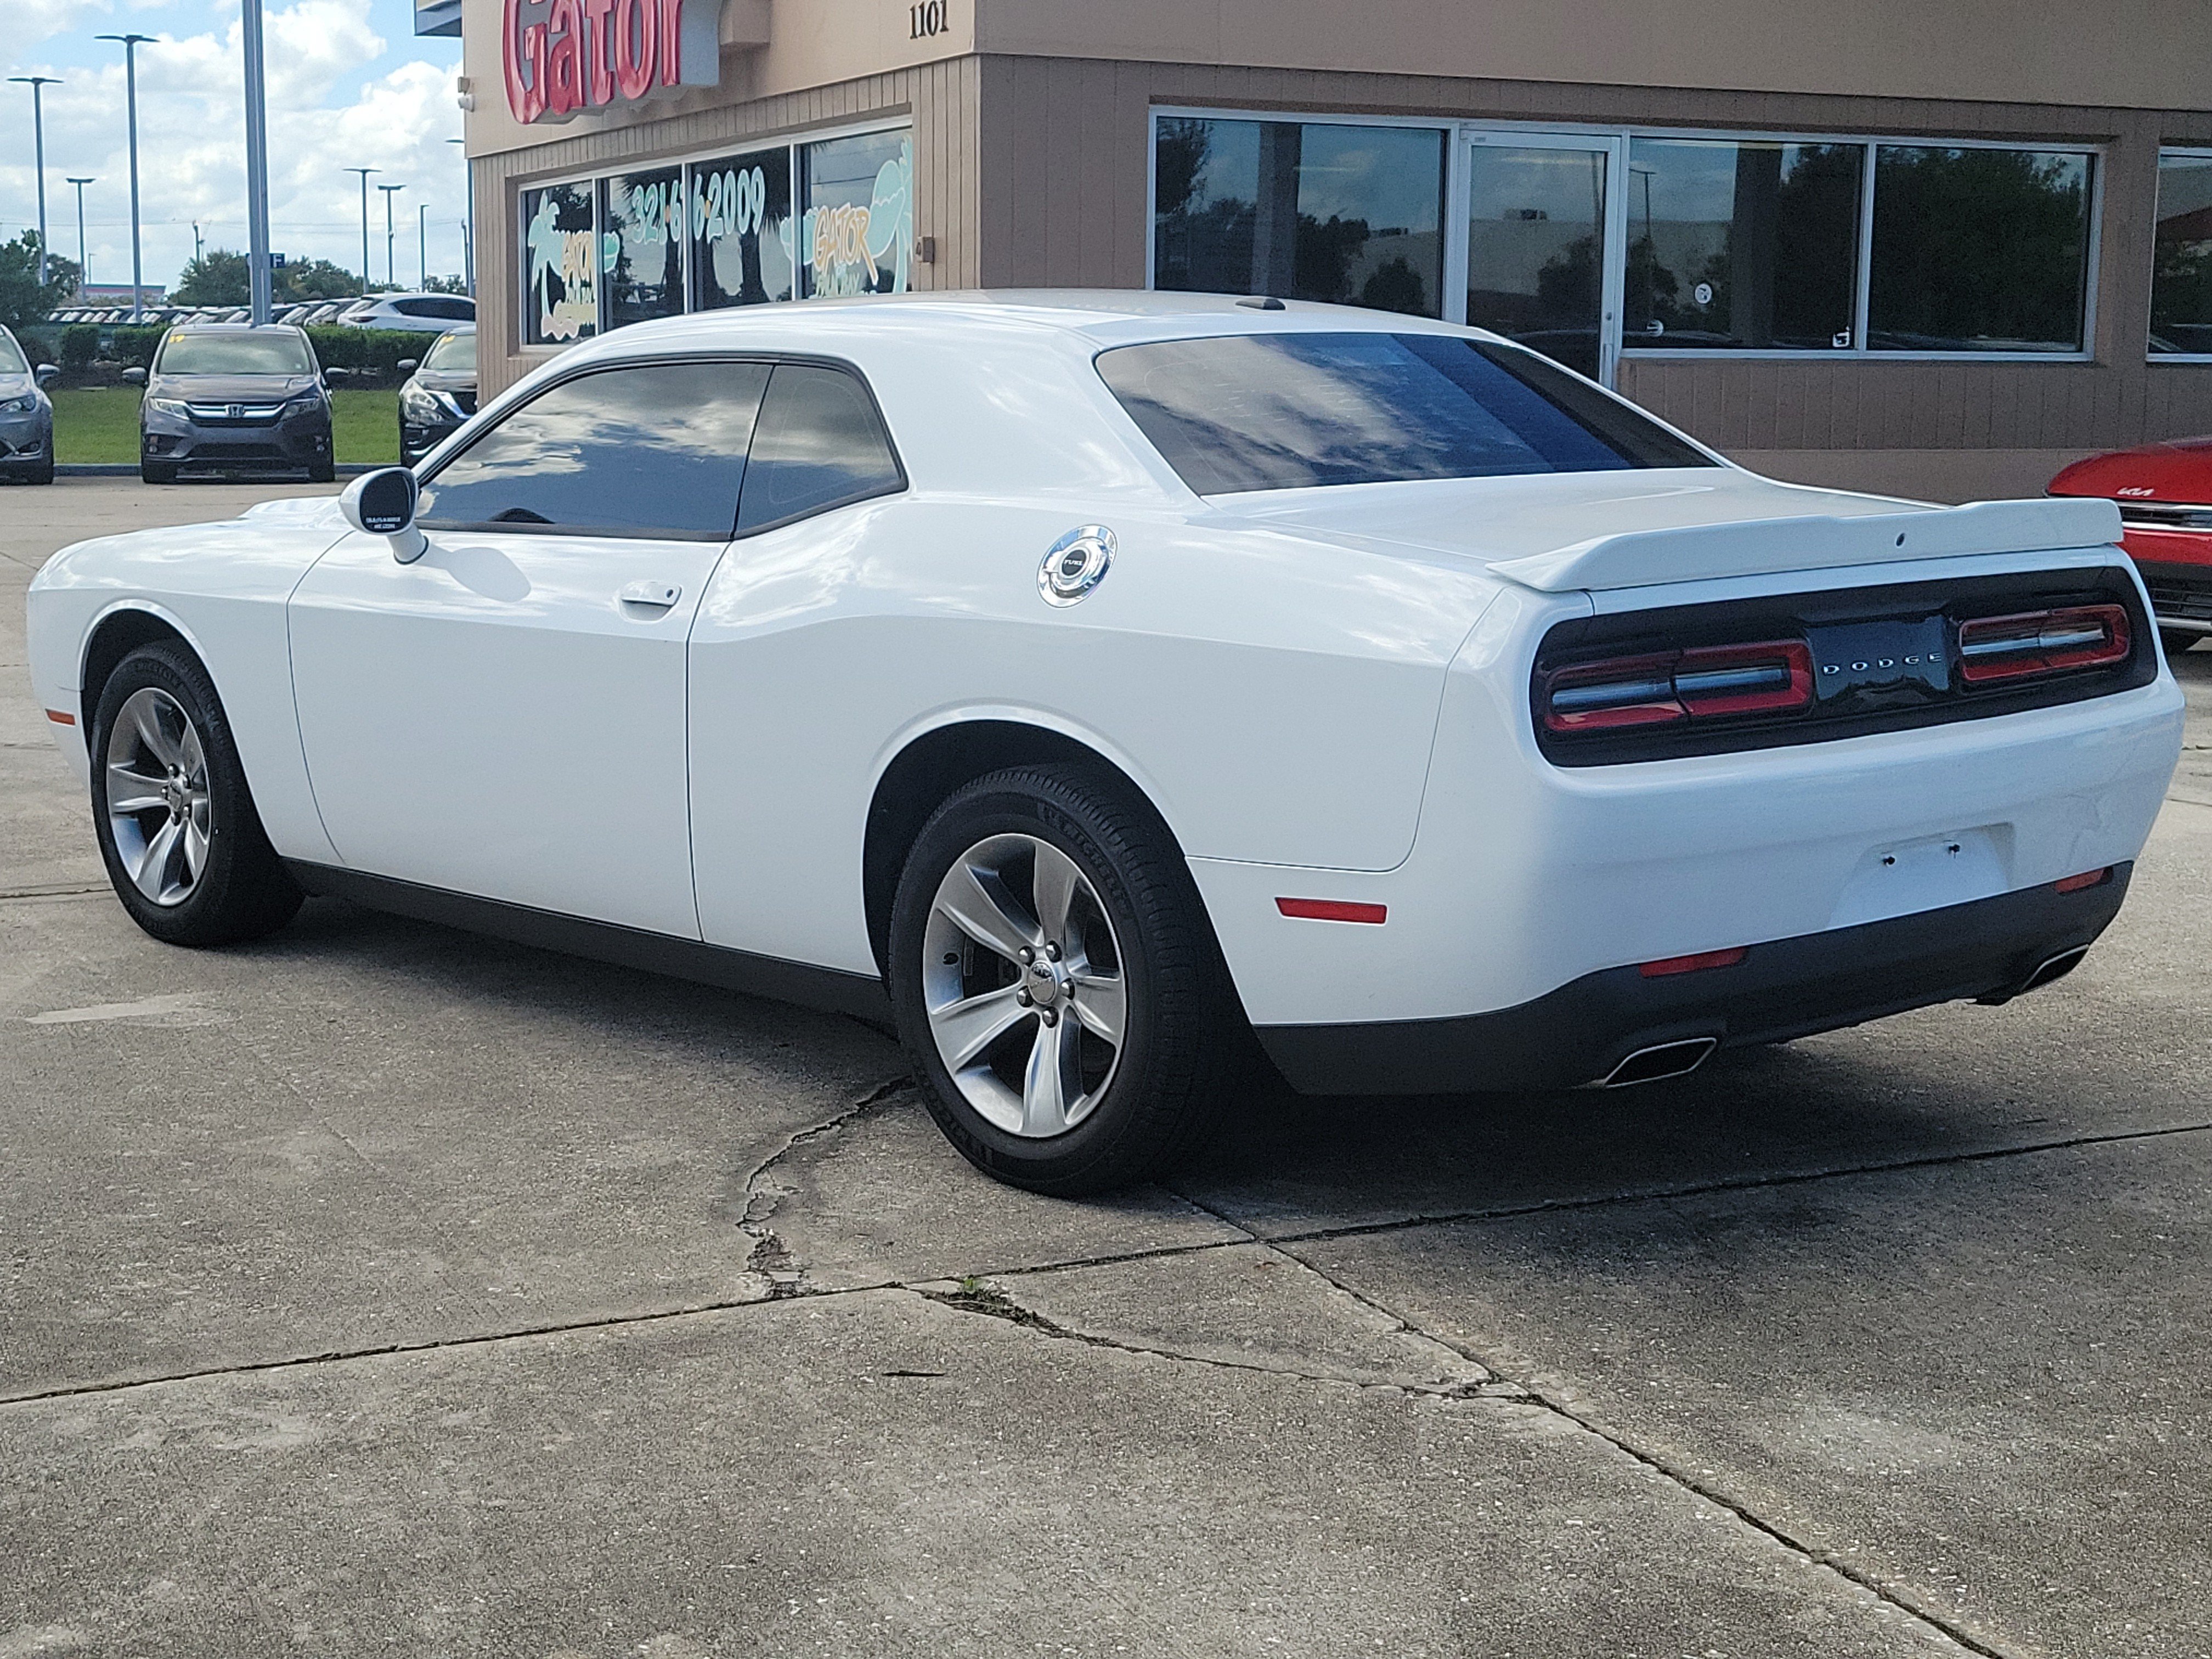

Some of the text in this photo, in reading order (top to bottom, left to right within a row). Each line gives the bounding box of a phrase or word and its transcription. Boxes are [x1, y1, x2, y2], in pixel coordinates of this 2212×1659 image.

[910, 0, 949, 40] 1101
[814, 202, 878, 286] GATOR
[1822, 652, 1942, 675] DODGE
